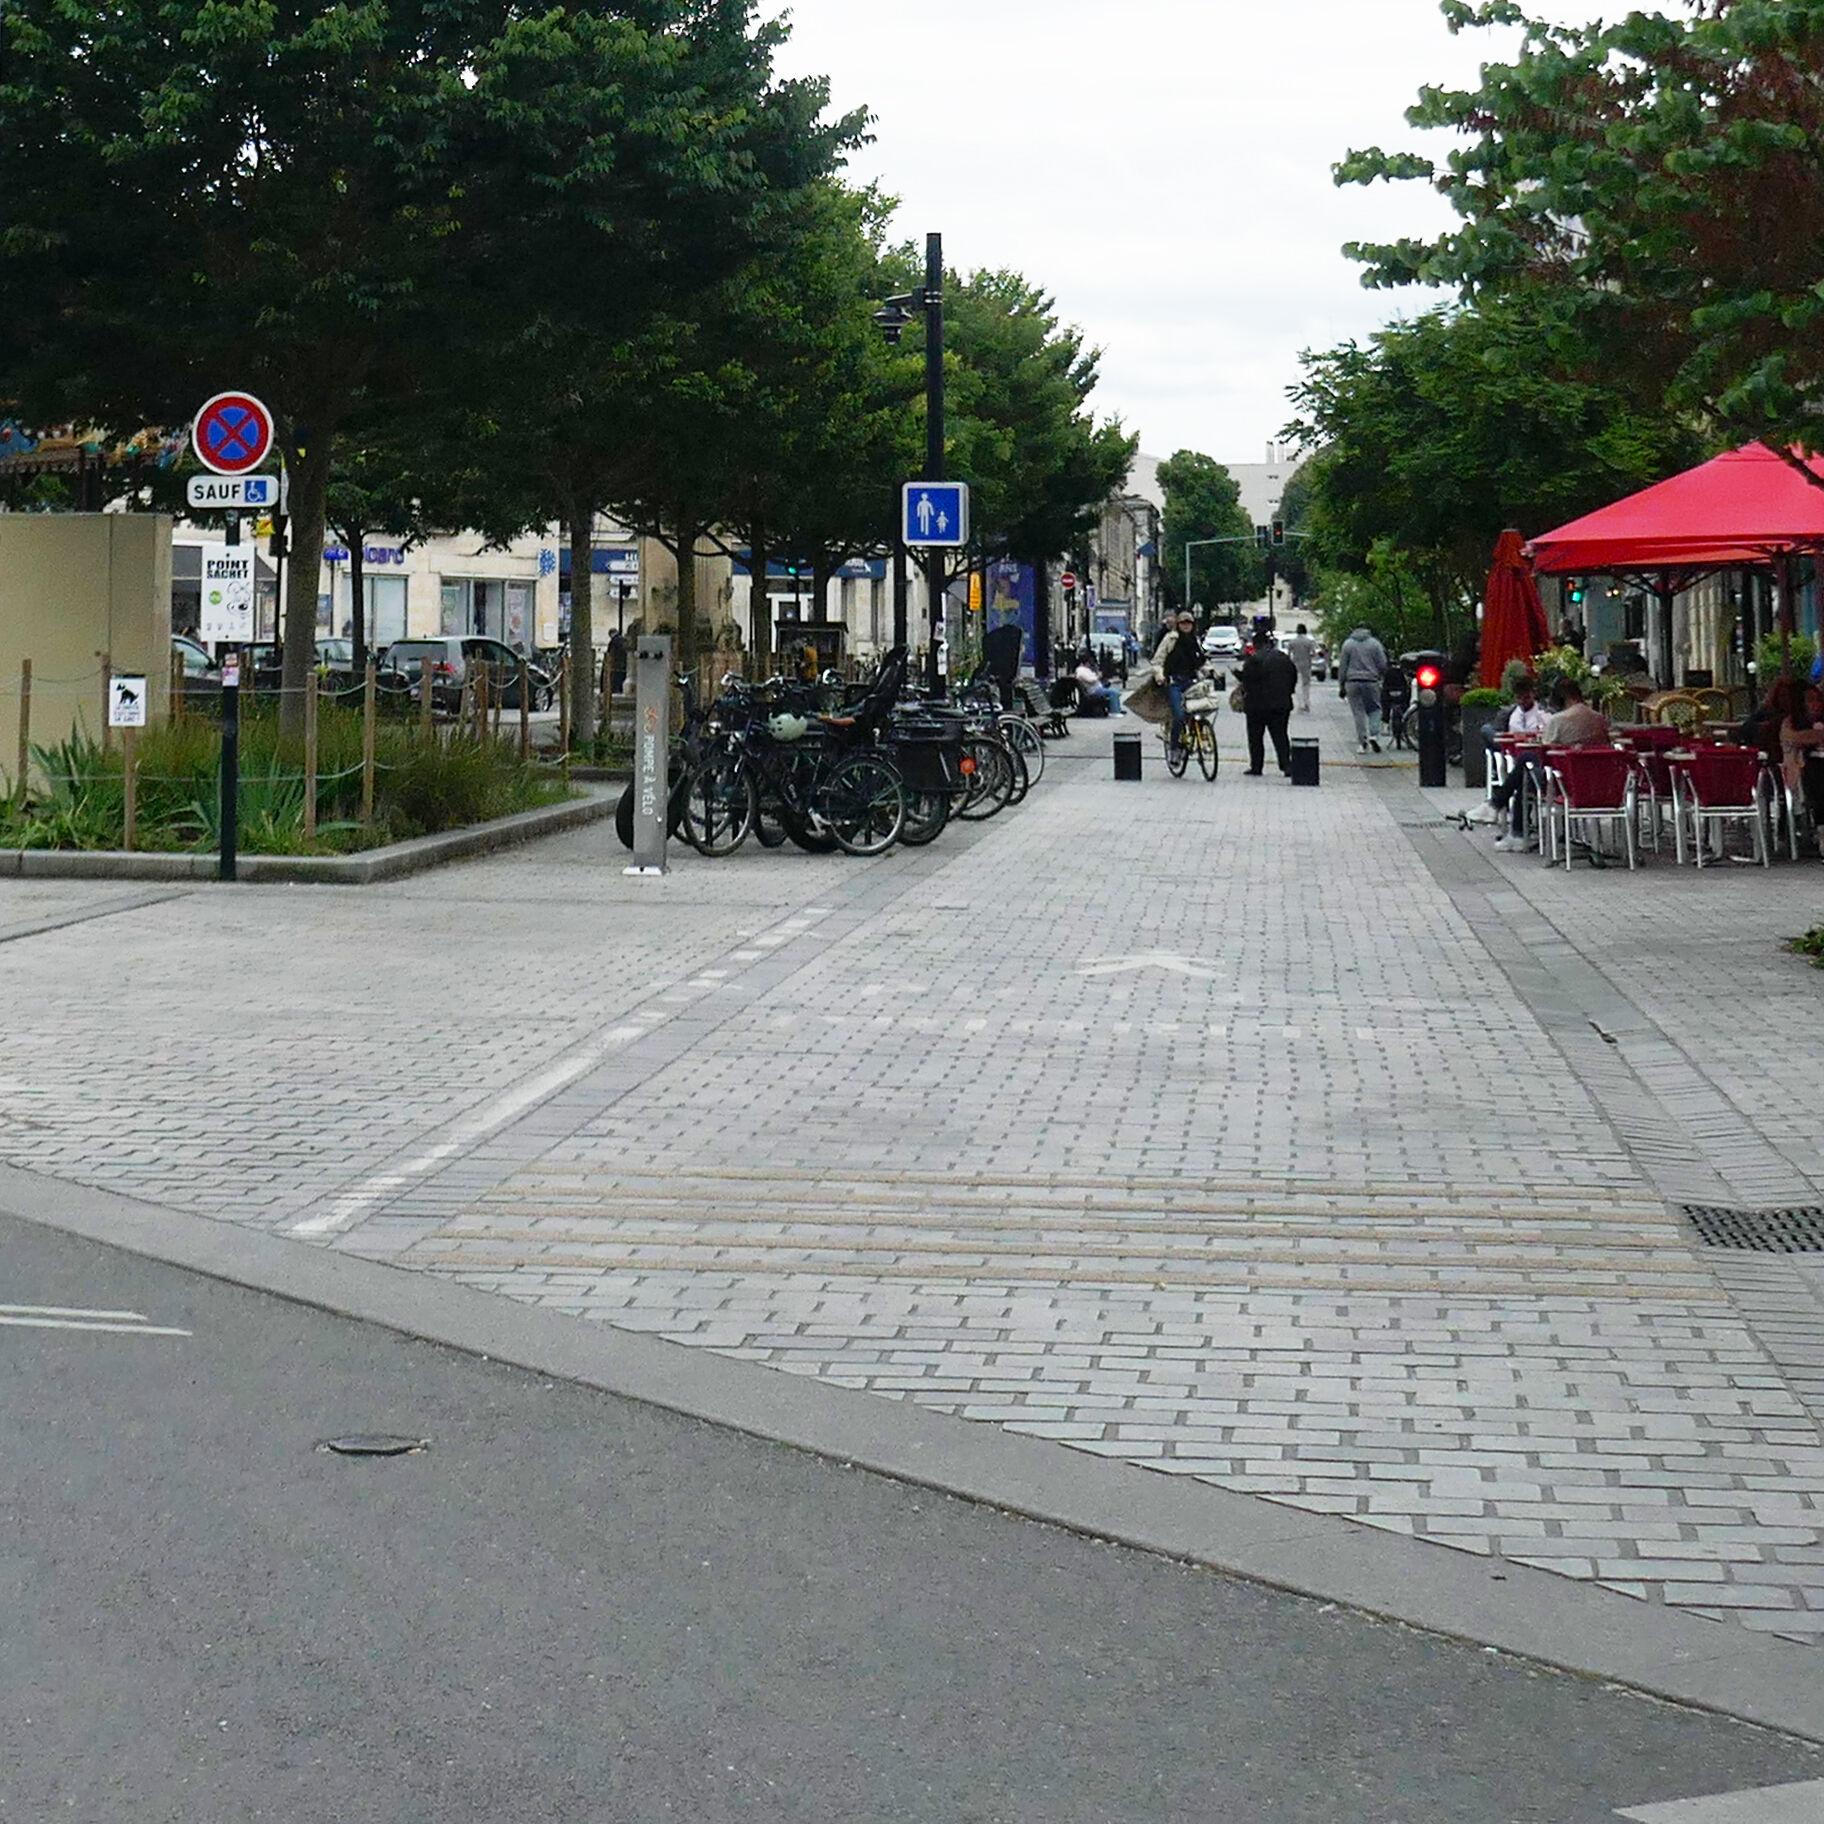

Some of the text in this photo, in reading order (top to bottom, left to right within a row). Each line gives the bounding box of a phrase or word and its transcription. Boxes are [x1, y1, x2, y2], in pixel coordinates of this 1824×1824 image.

[194, 483, 241, 500] SAUF
[207, 560, 249, 569] POINT
[207, 570, 249, 579] SACHET
